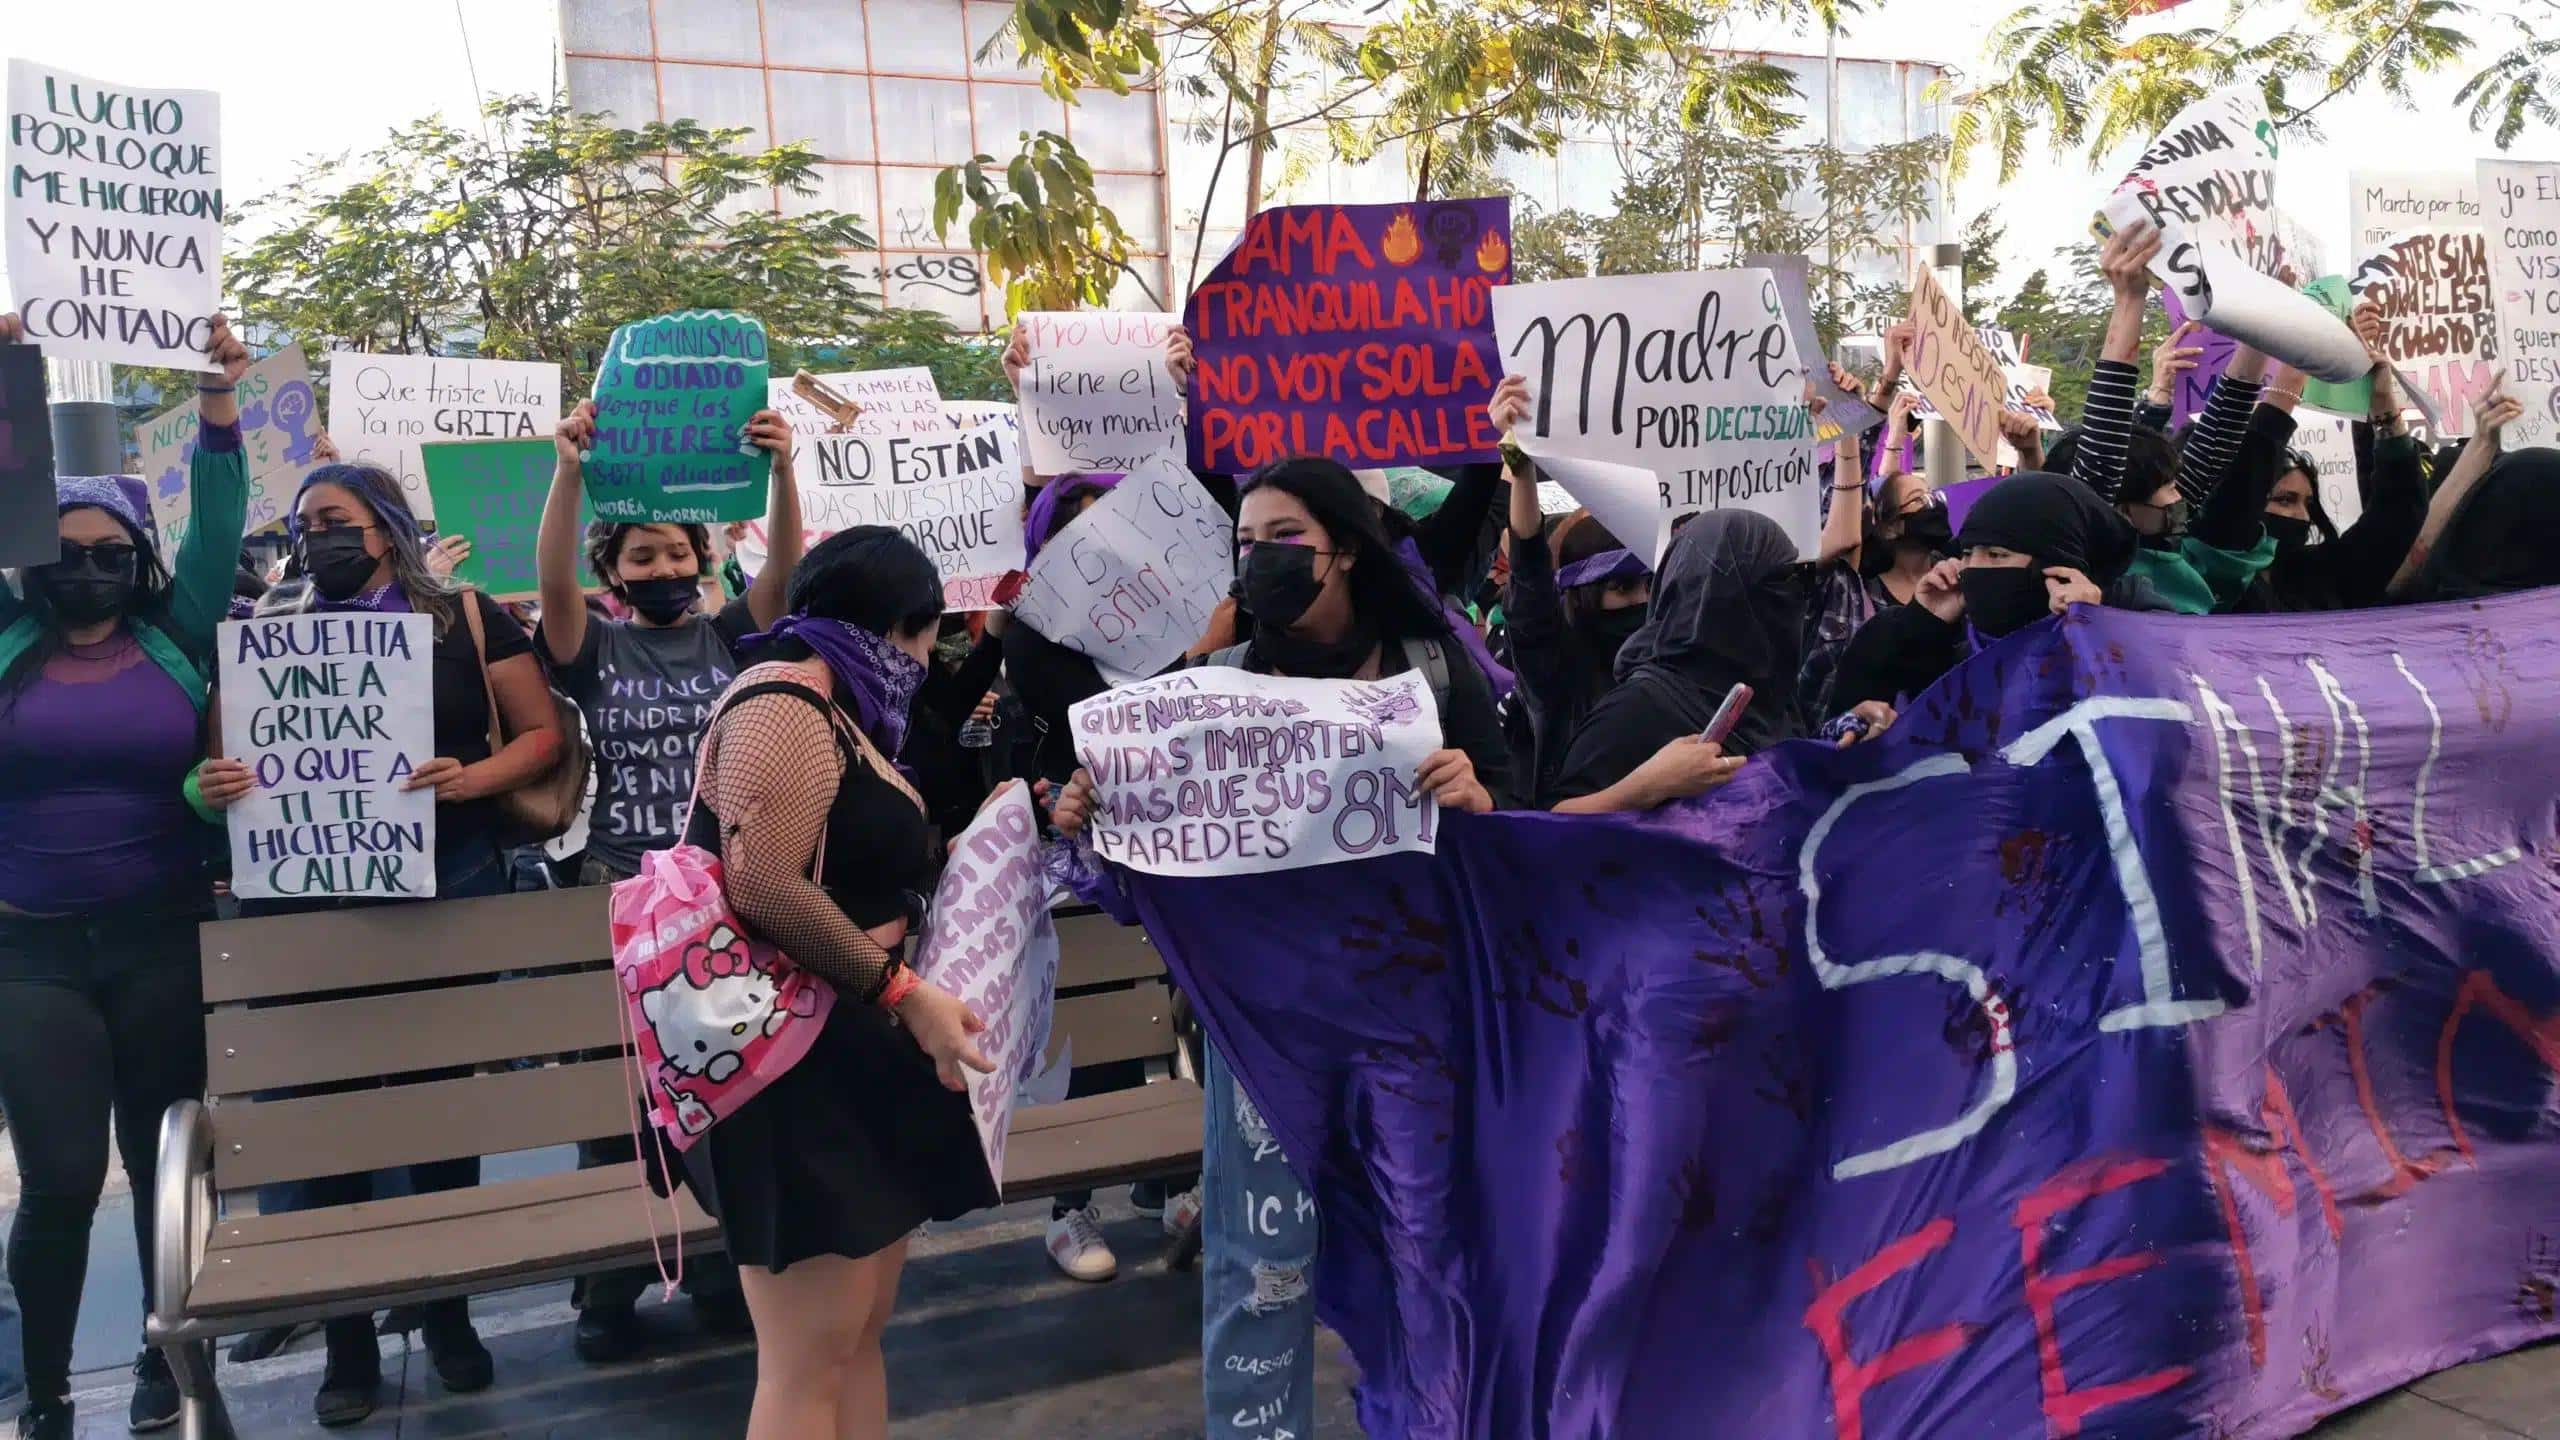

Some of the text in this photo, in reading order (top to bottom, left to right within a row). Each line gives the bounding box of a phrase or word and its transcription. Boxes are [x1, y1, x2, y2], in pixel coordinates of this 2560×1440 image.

[46, 76, 182, 134] LUCHO
[12, 113, 216, 177] POR LO QUE
[13, 165, 222, 223] ME HICIERON
[2366, 187, 2425, 215] Marcho
[26, 217, 203, 273] Y NUNCA
[81, 265, 133, 297] HE
[20, 297, 214, 353] CONTADO
[1194, 277, 1427, 340] TRANQUILA
[630, 324, 766, 361] FEMINISMO
[1511, 290, 1796, 439] Madre
[356, 366, 416, 402] Que
[426, 363, 486, 404] triste
[634, 362, 745, 390] ODIADO
[841, 375, 933, 395] TAMBIÉN
[1032, 355, 1156, 398] Tiene el
[1199, 340, 1490, 403] NO VOY SOLA
[358, 407, 536, 437] Ya no GRITA
[902, 400, 938, 414] LAS
[1036, 407, 1093, 449] lugar
[1636, 396, 1814, 449] POR DECISIÓN
[594, 424, 740, 456] MUJERES
[815, 430, 1003, 485] NO ESTÁN
[1203, 404, 1498, 469] POR LA CALLE
[800, 472, 1017, 526] ODAS NUESTRAS
[1679, 448, 1812, 509] IMPOSICIÓN
[900, 509, 999, 553] ORQUE
[238, 618, 412, 664] ABUELITA
[257, 660, 387, 700] VINE A
[250, 703, 392, 747] GRITAR
[597, 701, 715, 732] TENDRA
[1081, 702, 1142, 735] QUE
[248, 748, 416, 788] O QUE A
[1084, 719, 1384, 786] VIDAS IMPORTEN
[270, 789, 380, 824] TI TE
[609, 802, 689, 836] SILE
[1098, 769, 1332, 826] MAS QUE SUS
[1333, 767, 1433, 854] 8M
[248, 820, 424, 862] HICIERON
[967, 803, 1031, 865] no
[1100, 819, 1291, 866] PAREDES
[269, 854, 412, 895] CALLAR
[936, 916, 1017, 998] untas
